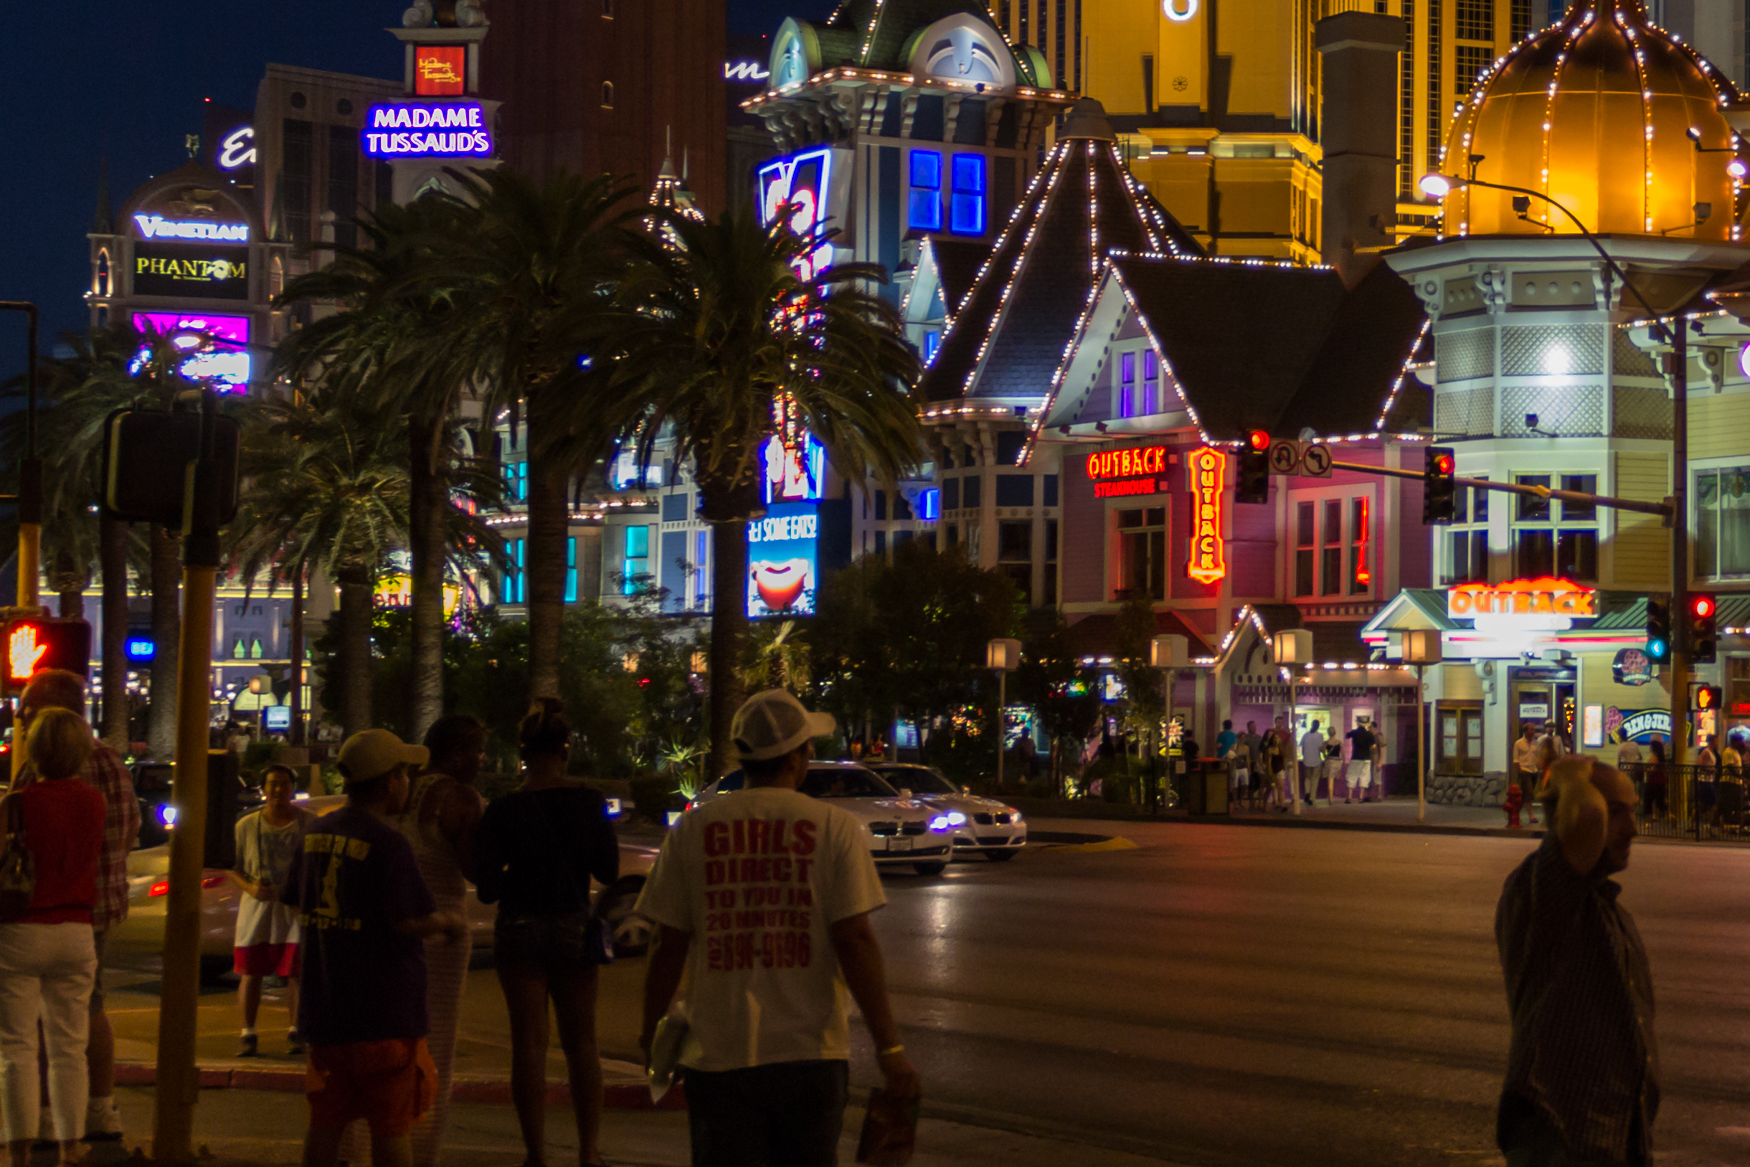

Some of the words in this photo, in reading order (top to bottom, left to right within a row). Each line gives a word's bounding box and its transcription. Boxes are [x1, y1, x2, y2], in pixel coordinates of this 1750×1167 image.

[374, 108, 481, 127] MADAME
[367, 130, 489, 152] TUSSAUD'S
[134, 215, 249, 241] VENETIAN
[1087, 446, 1166, 479] OUTBACK
[1094, 478, 1156, 498] STEAKHOUSE
[1200, 453, 1216, 569] OUTBACK
[1451, 591, 1594, 615] OUTBACK
[703, 818, 817, 858] GIRLS
[704, 857, 814, 887] DIRECT
[704, 889, 736, 910] TO
[743, 886, 782, 908] YOU
[788, 887, 812, 907] IN
[706, 911, 732, 932] 20
[735, 909, 812, 930] MINUTES
